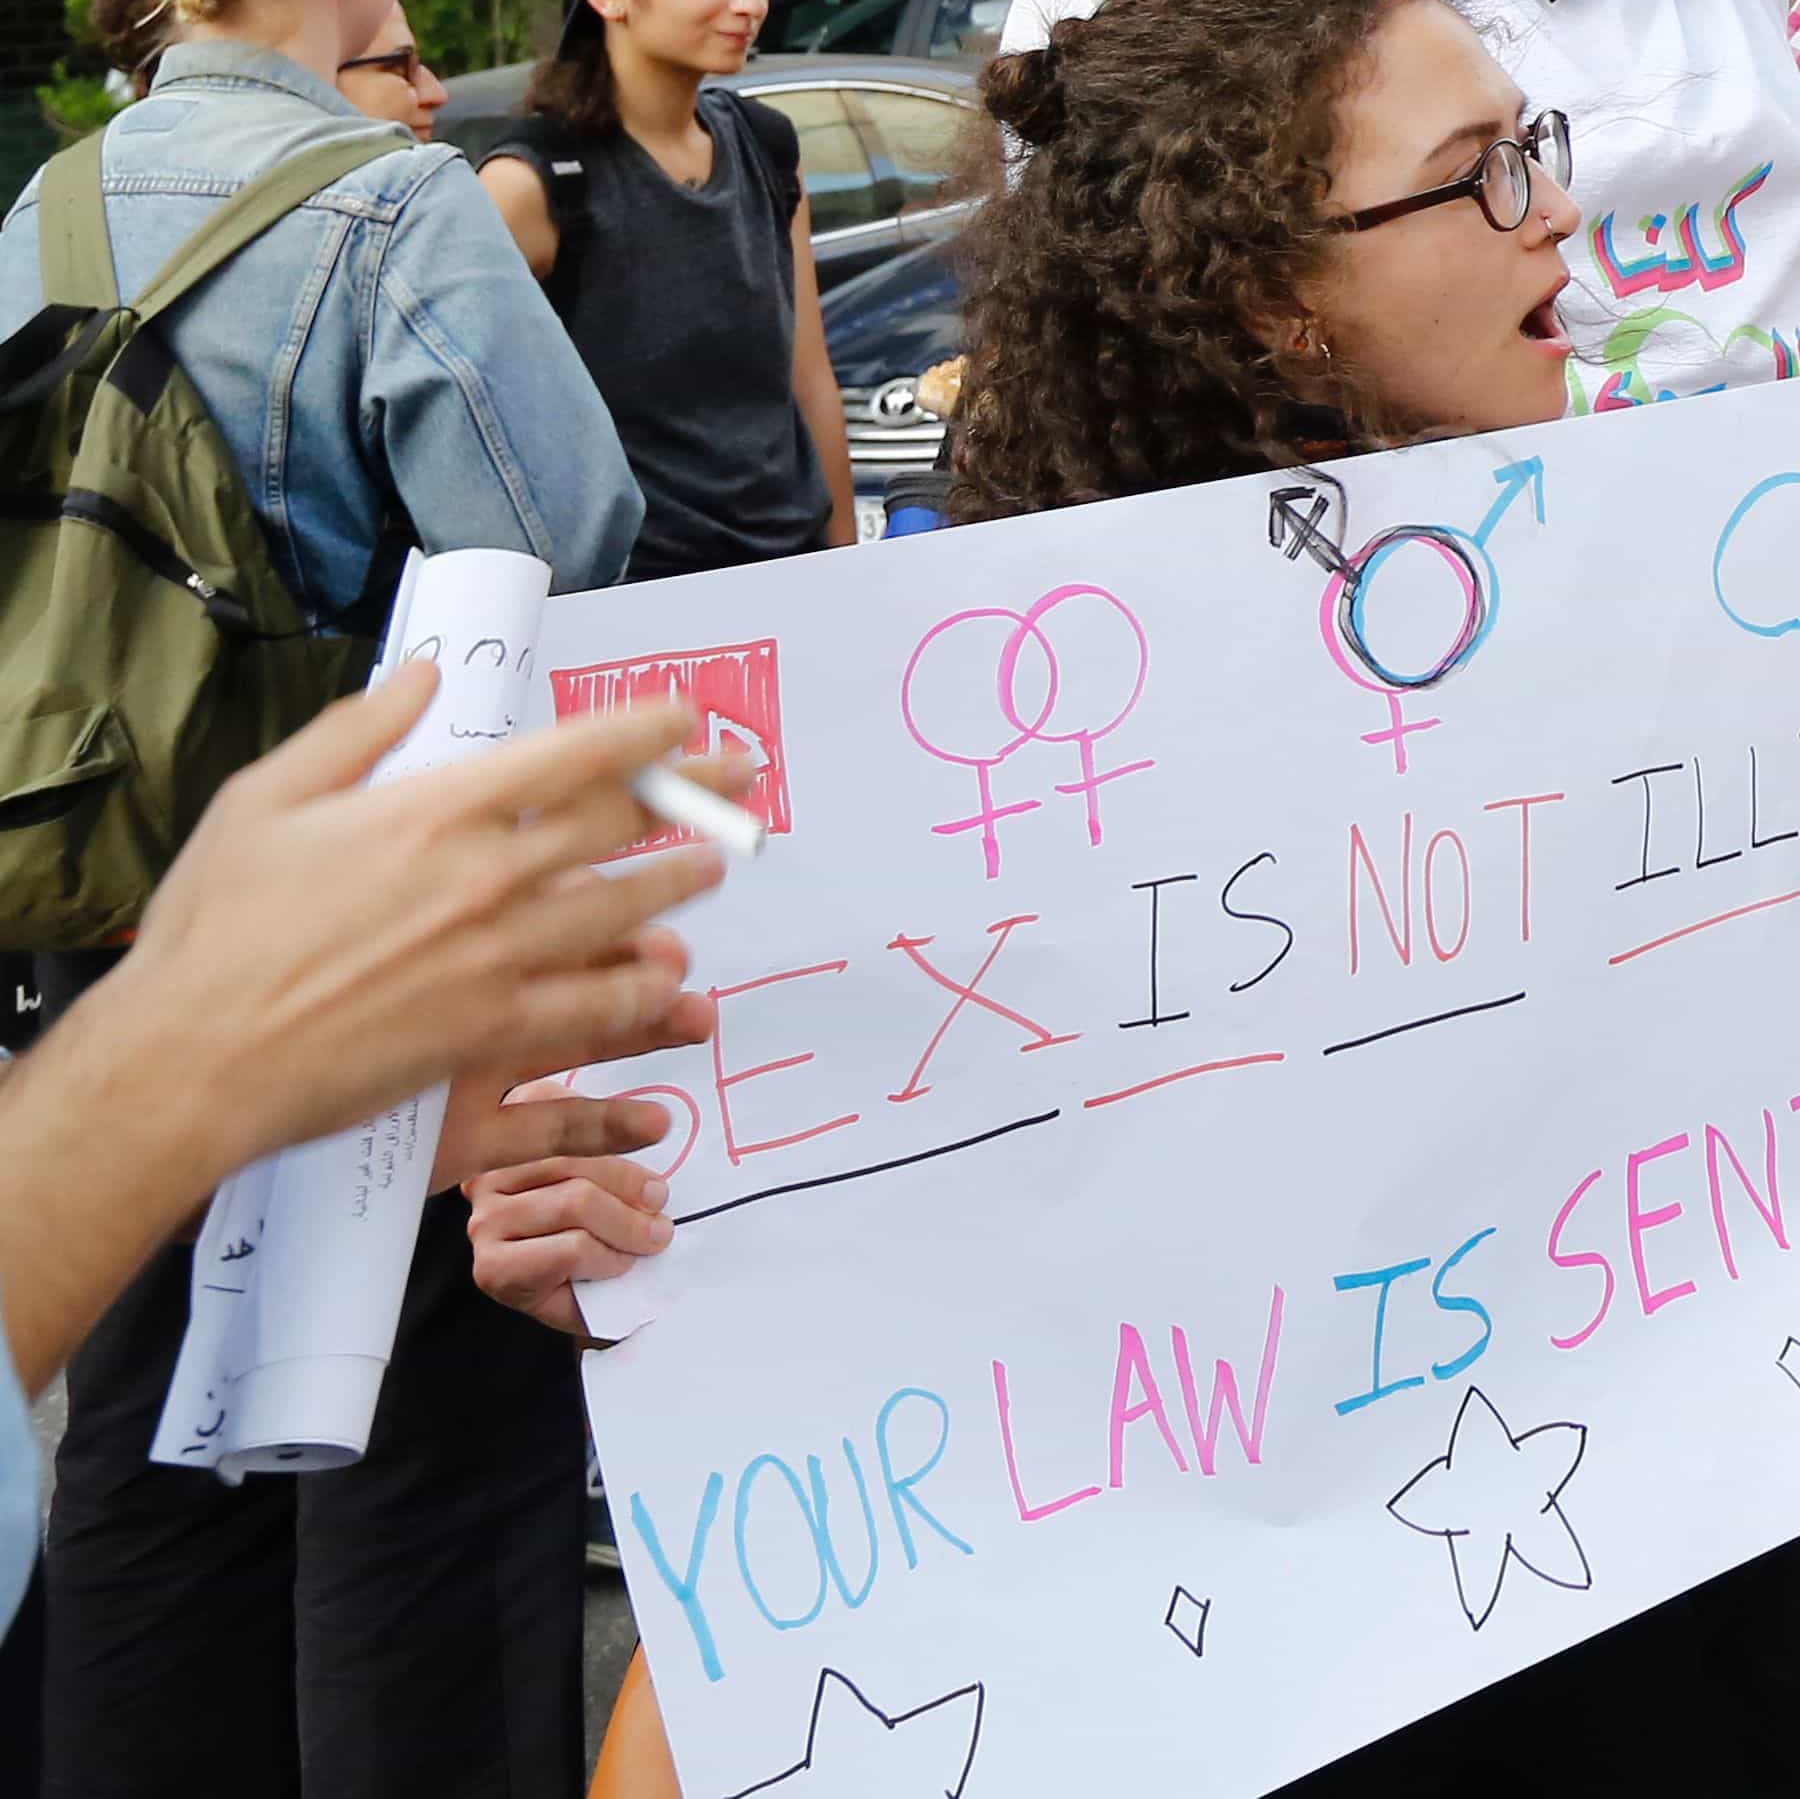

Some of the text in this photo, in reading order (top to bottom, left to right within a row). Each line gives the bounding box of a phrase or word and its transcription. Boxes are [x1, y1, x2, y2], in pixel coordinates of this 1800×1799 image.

[1587, 160, 1774, 300] كلنا
[1118, 851, 1294, 1031] IS
[1349, 792, 1565, 976] NOT
[632, 1386, 974, 1684] YOUR
[992, 1284, 1284, 1522] LAW
[1333, 1225, 1500, 1418] IS
